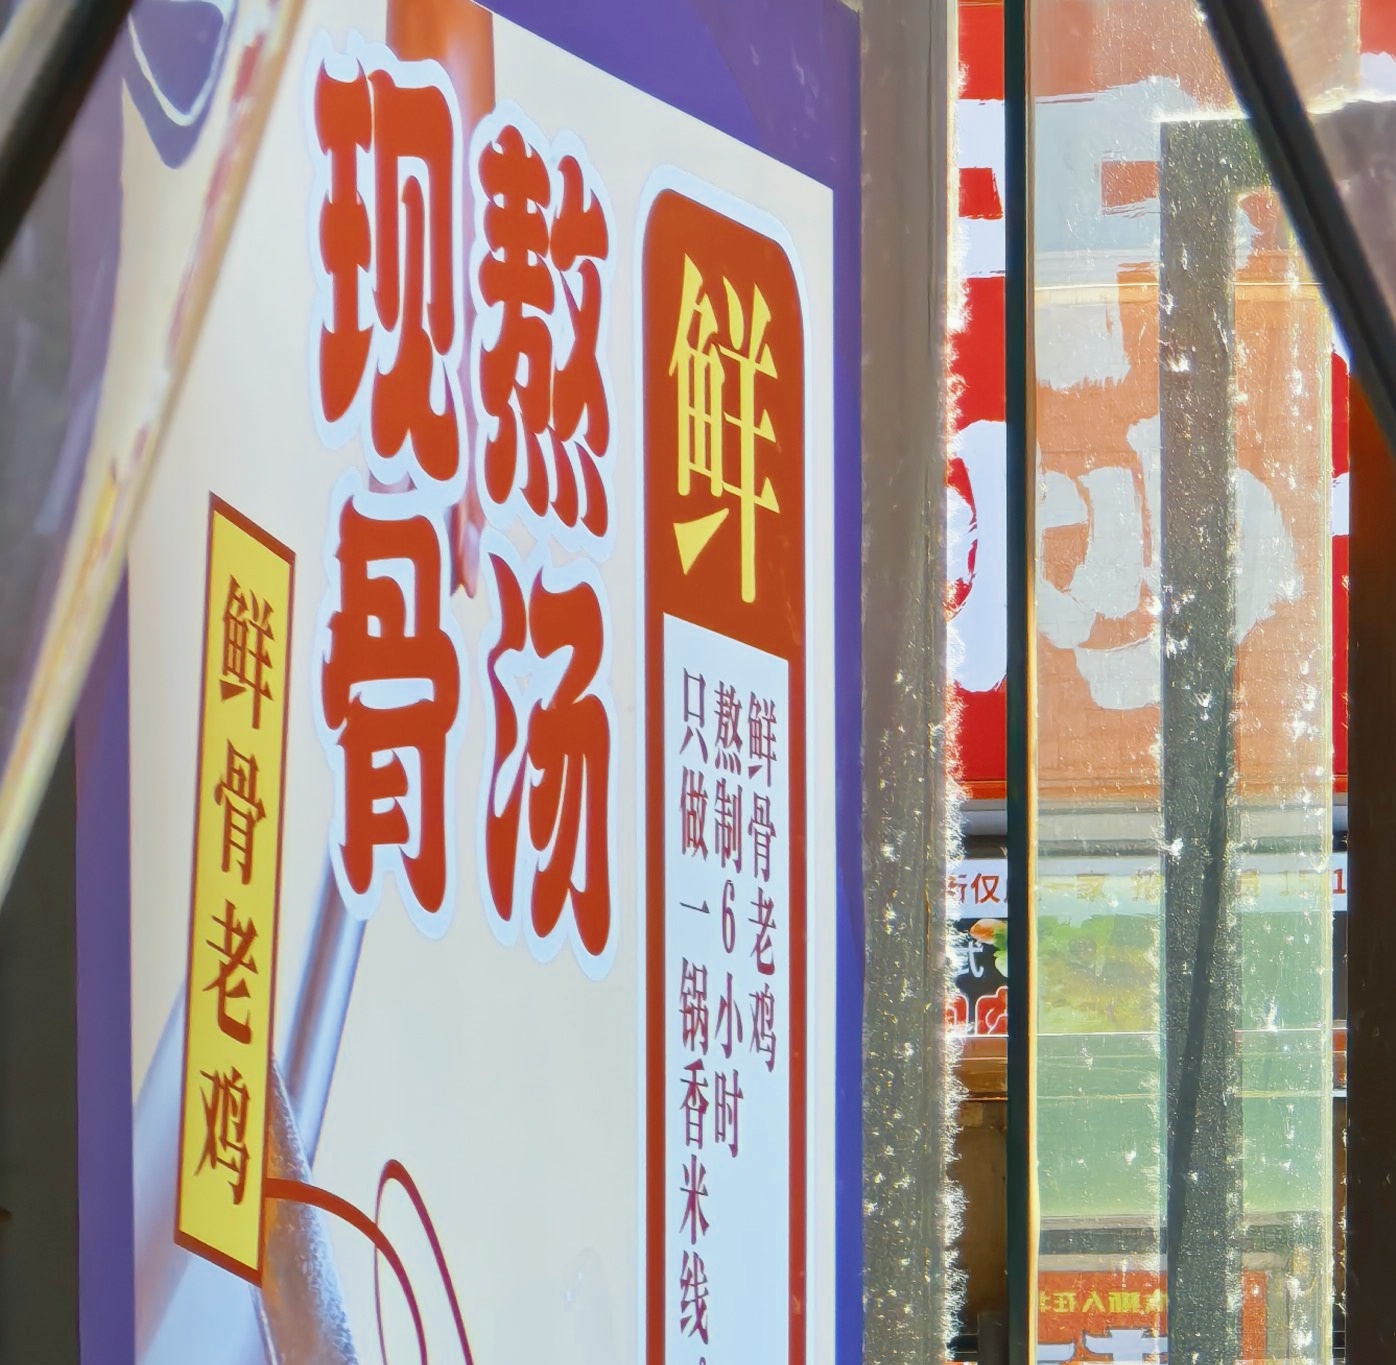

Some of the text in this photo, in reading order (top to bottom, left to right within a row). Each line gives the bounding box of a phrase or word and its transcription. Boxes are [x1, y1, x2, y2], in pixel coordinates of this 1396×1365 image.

[667, 252, 781, 603] 鲜
[195, 573, 276, 1206] 鲜骨老鸡
[713, 681, 744, 1158] 熬制6小时
[746, 690, 778, 1073] 鲜骨老鸡
